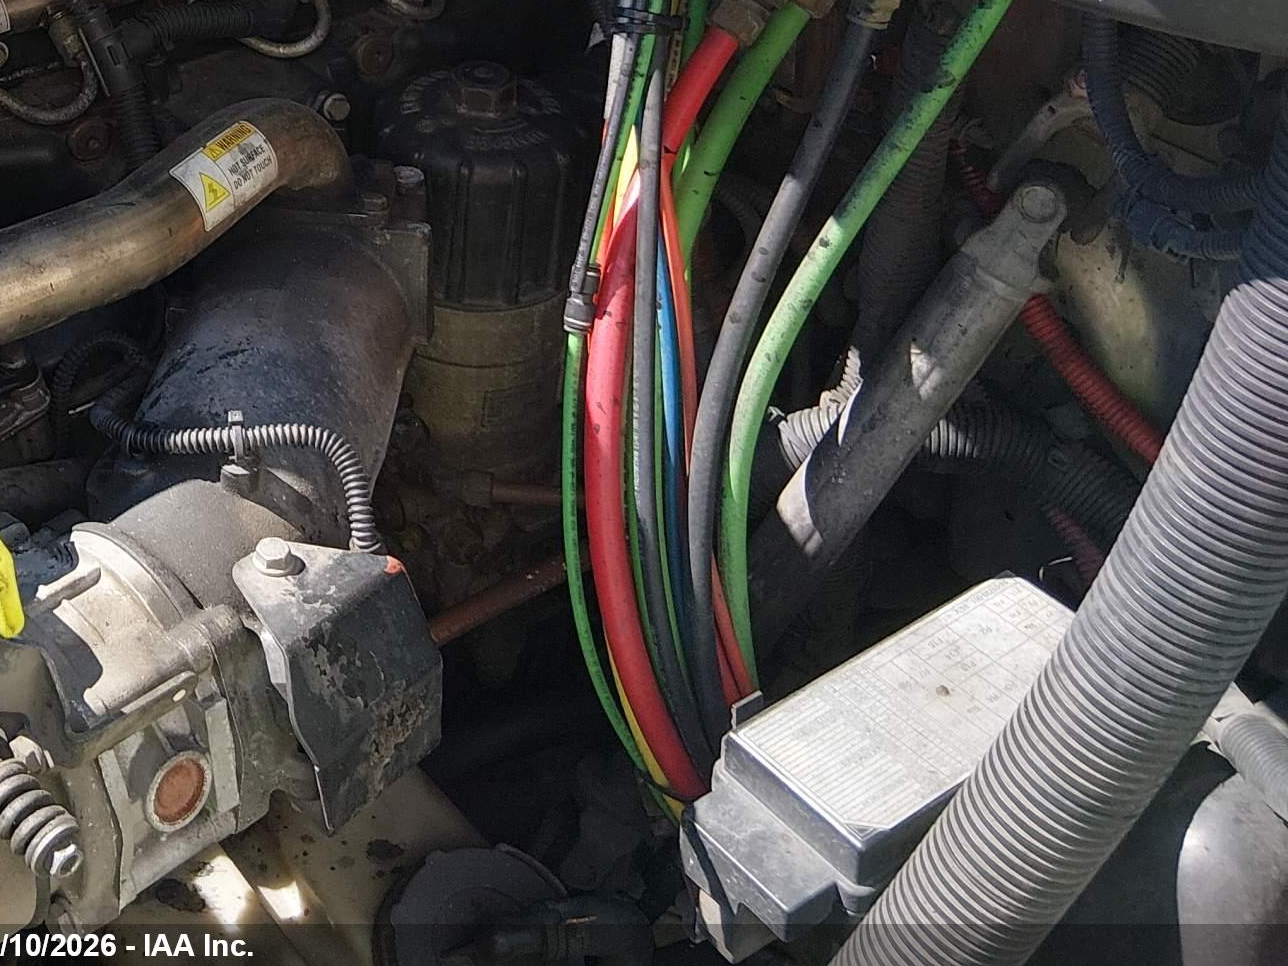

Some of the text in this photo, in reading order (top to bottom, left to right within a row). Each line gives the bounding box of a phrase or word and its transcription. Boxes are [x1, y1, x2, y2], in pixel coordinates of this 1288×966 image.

[215, 125, 252, 151] WARNING
[228, 144, 265, 176] HOT SURFACE
